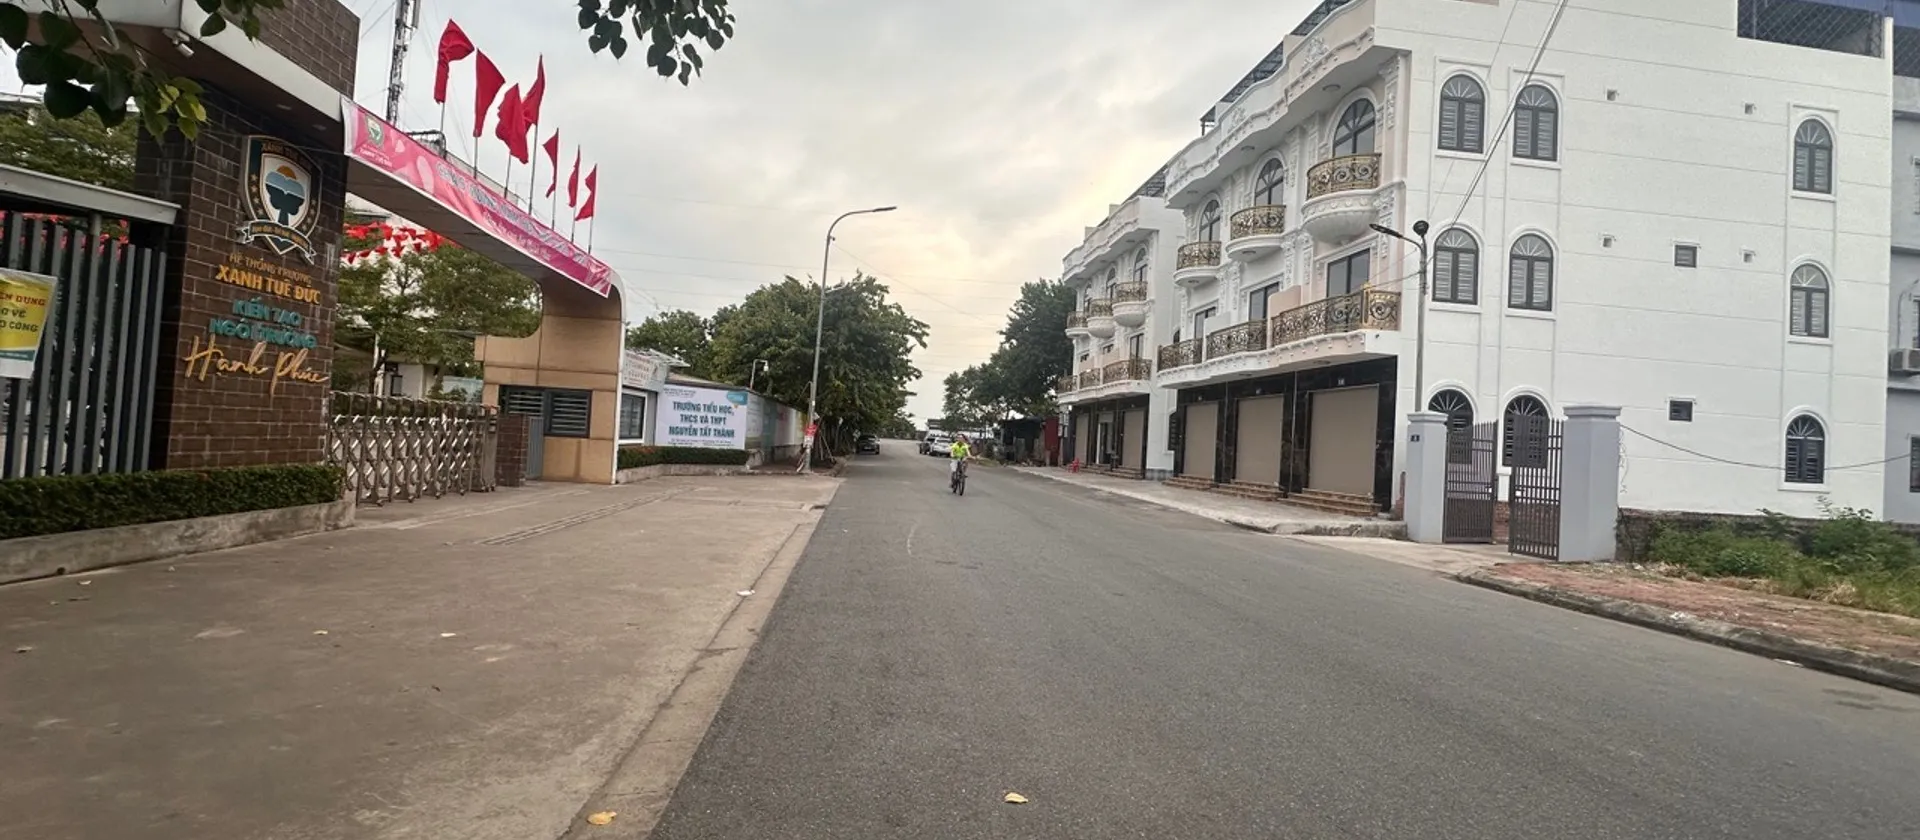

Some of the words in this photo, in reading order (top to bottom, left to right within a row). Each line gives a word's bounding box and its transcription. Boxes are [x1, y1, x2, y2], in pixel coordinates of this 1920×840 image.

[246, 257, 276, 275] THỐNG
[215, 264, 262, 290] XANH
[265, 277, 291, 298] TUỆ
[294, 284, 321, 305] ĐỨC
[233, 296, 271, 321] KIẾN
[209, 317, 261, 341] NGÔI
[260, 325, 317, 349] TRƯỜNG
[184, 333, 268, 382] Hạnh
[270, 346, 329, 400] Phúc
[672, 400, 701, 413] TRƯỜNG
[703, 401, 718, 413] TIỂU
[718, 405, 735, 416] HỌC,
[680, 414, 698, 424] THCS
[699, 414, 709, 424] VÀ
[710, 416, 727, 425] THPT
[668, 424, 698, 436] NGUYỄN
[699, 426, 712, 437] TẤT
[713, 428, 735, 438] THÀNH
